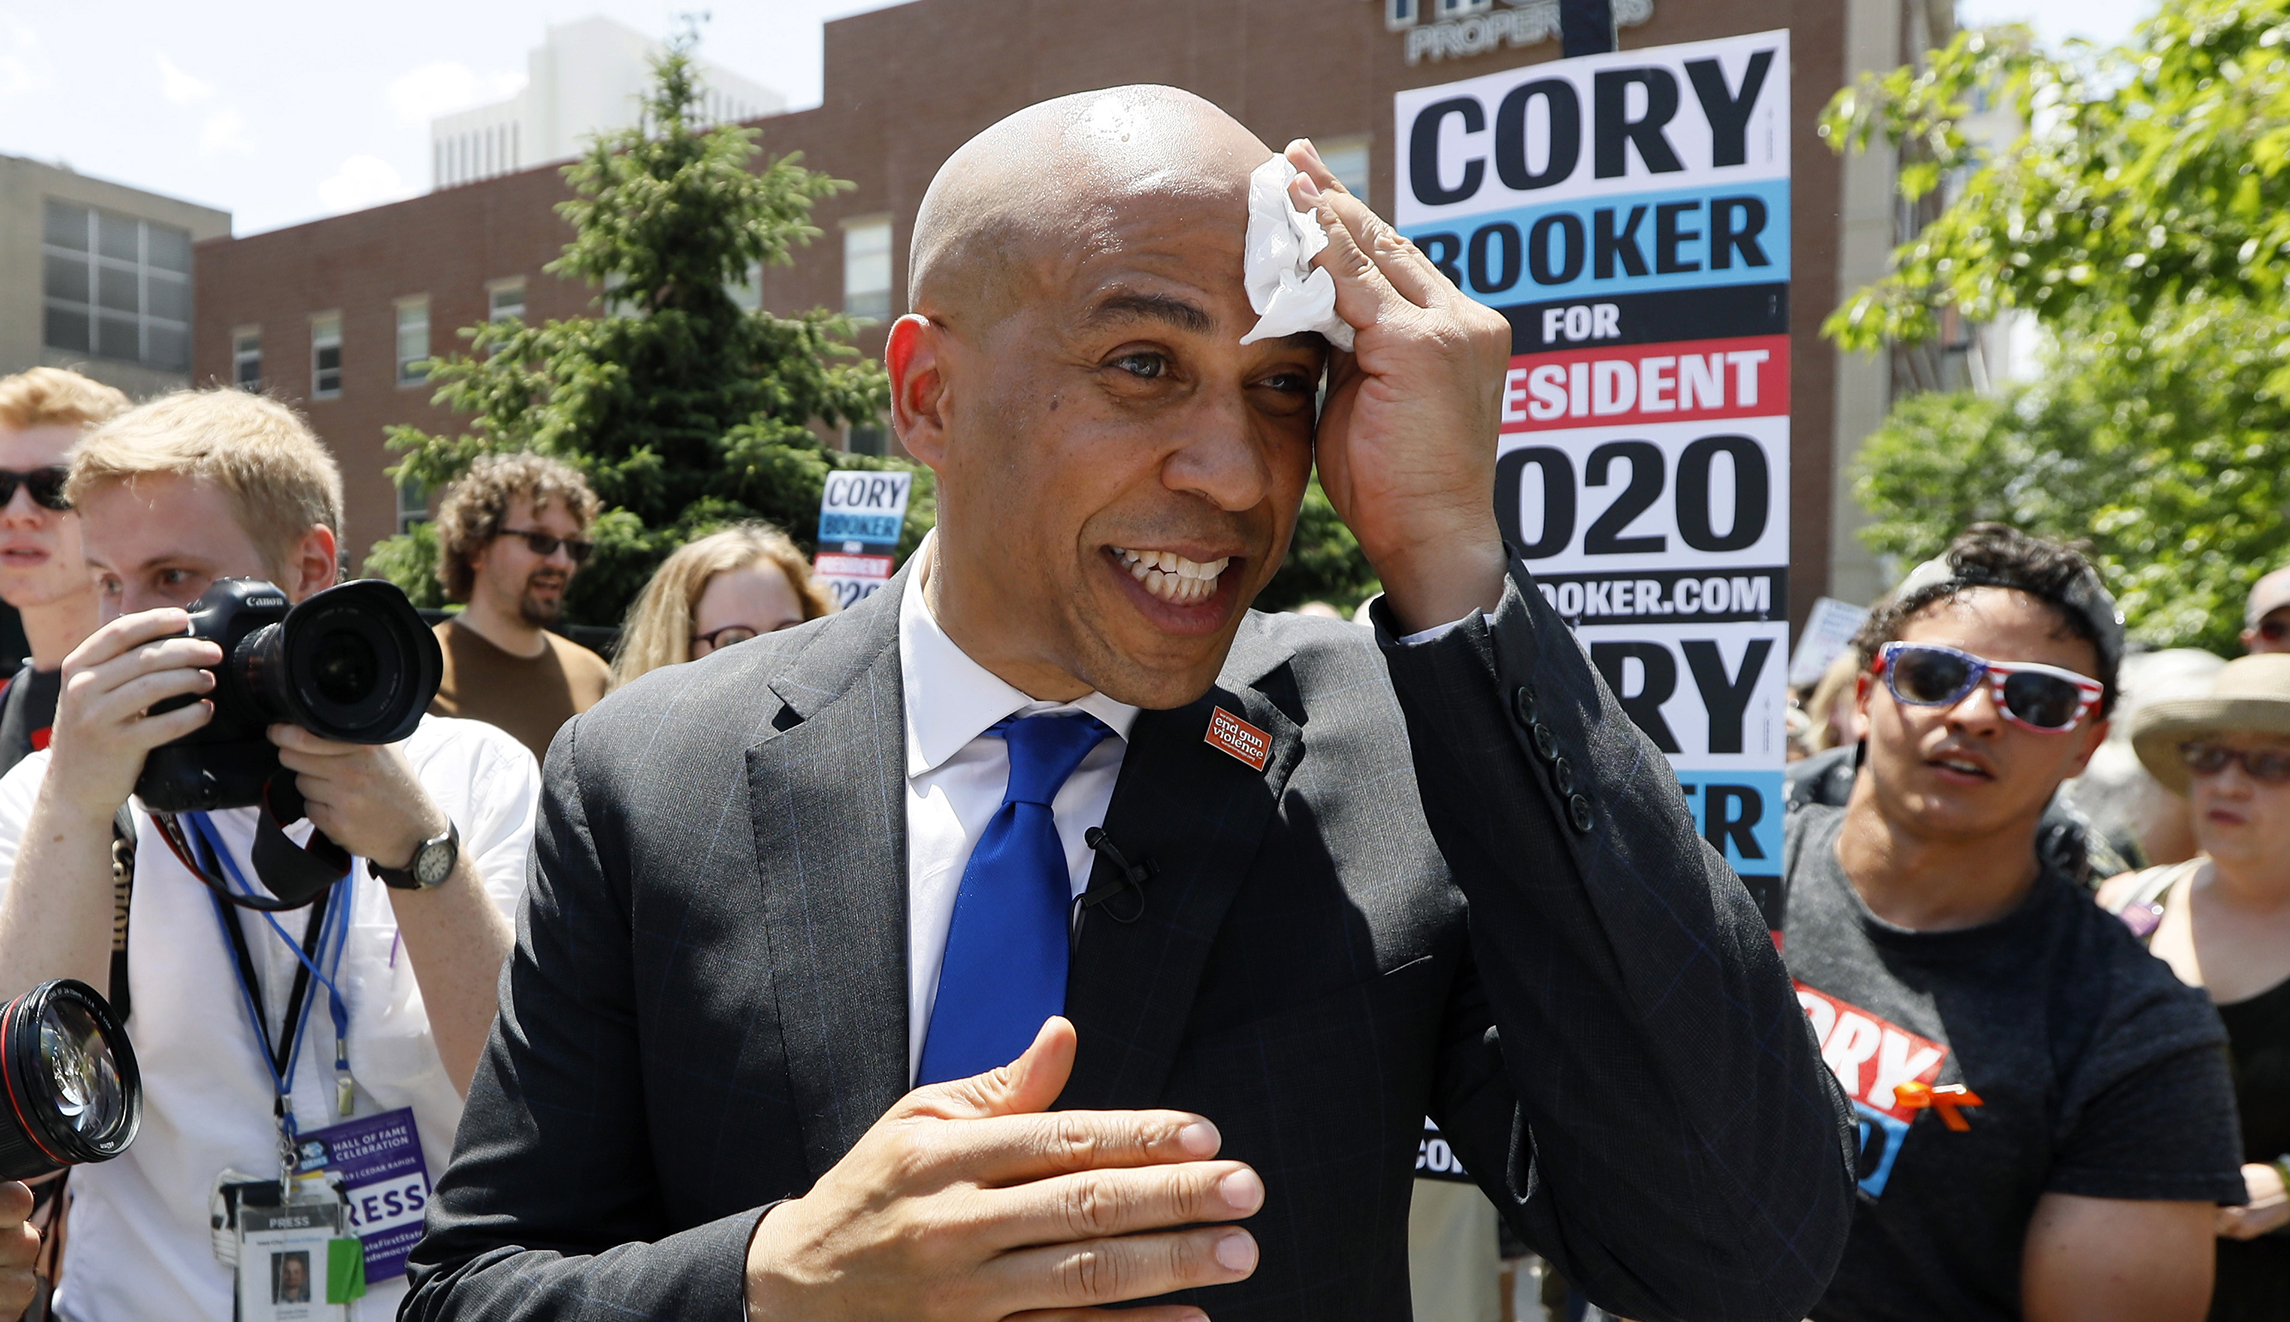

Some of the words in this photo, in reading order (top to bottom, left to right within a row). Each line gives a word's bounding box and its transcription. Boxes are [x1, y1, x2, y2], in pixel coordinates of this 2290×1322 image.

[1404, 0, 1653, 66] PROPERS
[1409, 47, 1779, 206] CORY
[1412, 194, 1773, 295] BOOKER
[1542, 302, 1621, 343] FOR
[1502, 349, 1770, 424] ESIDENT
[828, 477, 907, 508] CORY
[1493, 433, 1772, 560] 020
[825, 514, 897, 537] BOOKER
[245, 596, 284, 607] Canon
[1537, 576, 1770, 618] OOKER.COM
[1590, 638, 1776, 755] RY
[1213, 726, 1264, 760] violence
[1214, 717, 1240, 735] end
[1239, 730, 1263, 748] gun
[332, 1138, 361, 1153] HALL
[362, 1133, 377, 1145] OF
[379, 1126, 408, 1140] FAME
[335, 1136, 410, 1162] CELEBRATION
[360, 1164, 387, 1178] CEDAR
[387, 1156, 416, 1170] RAPIDS
[268, 1216, 311, 1229] PRESS
[349, 1184, 425, 1227] RESS
